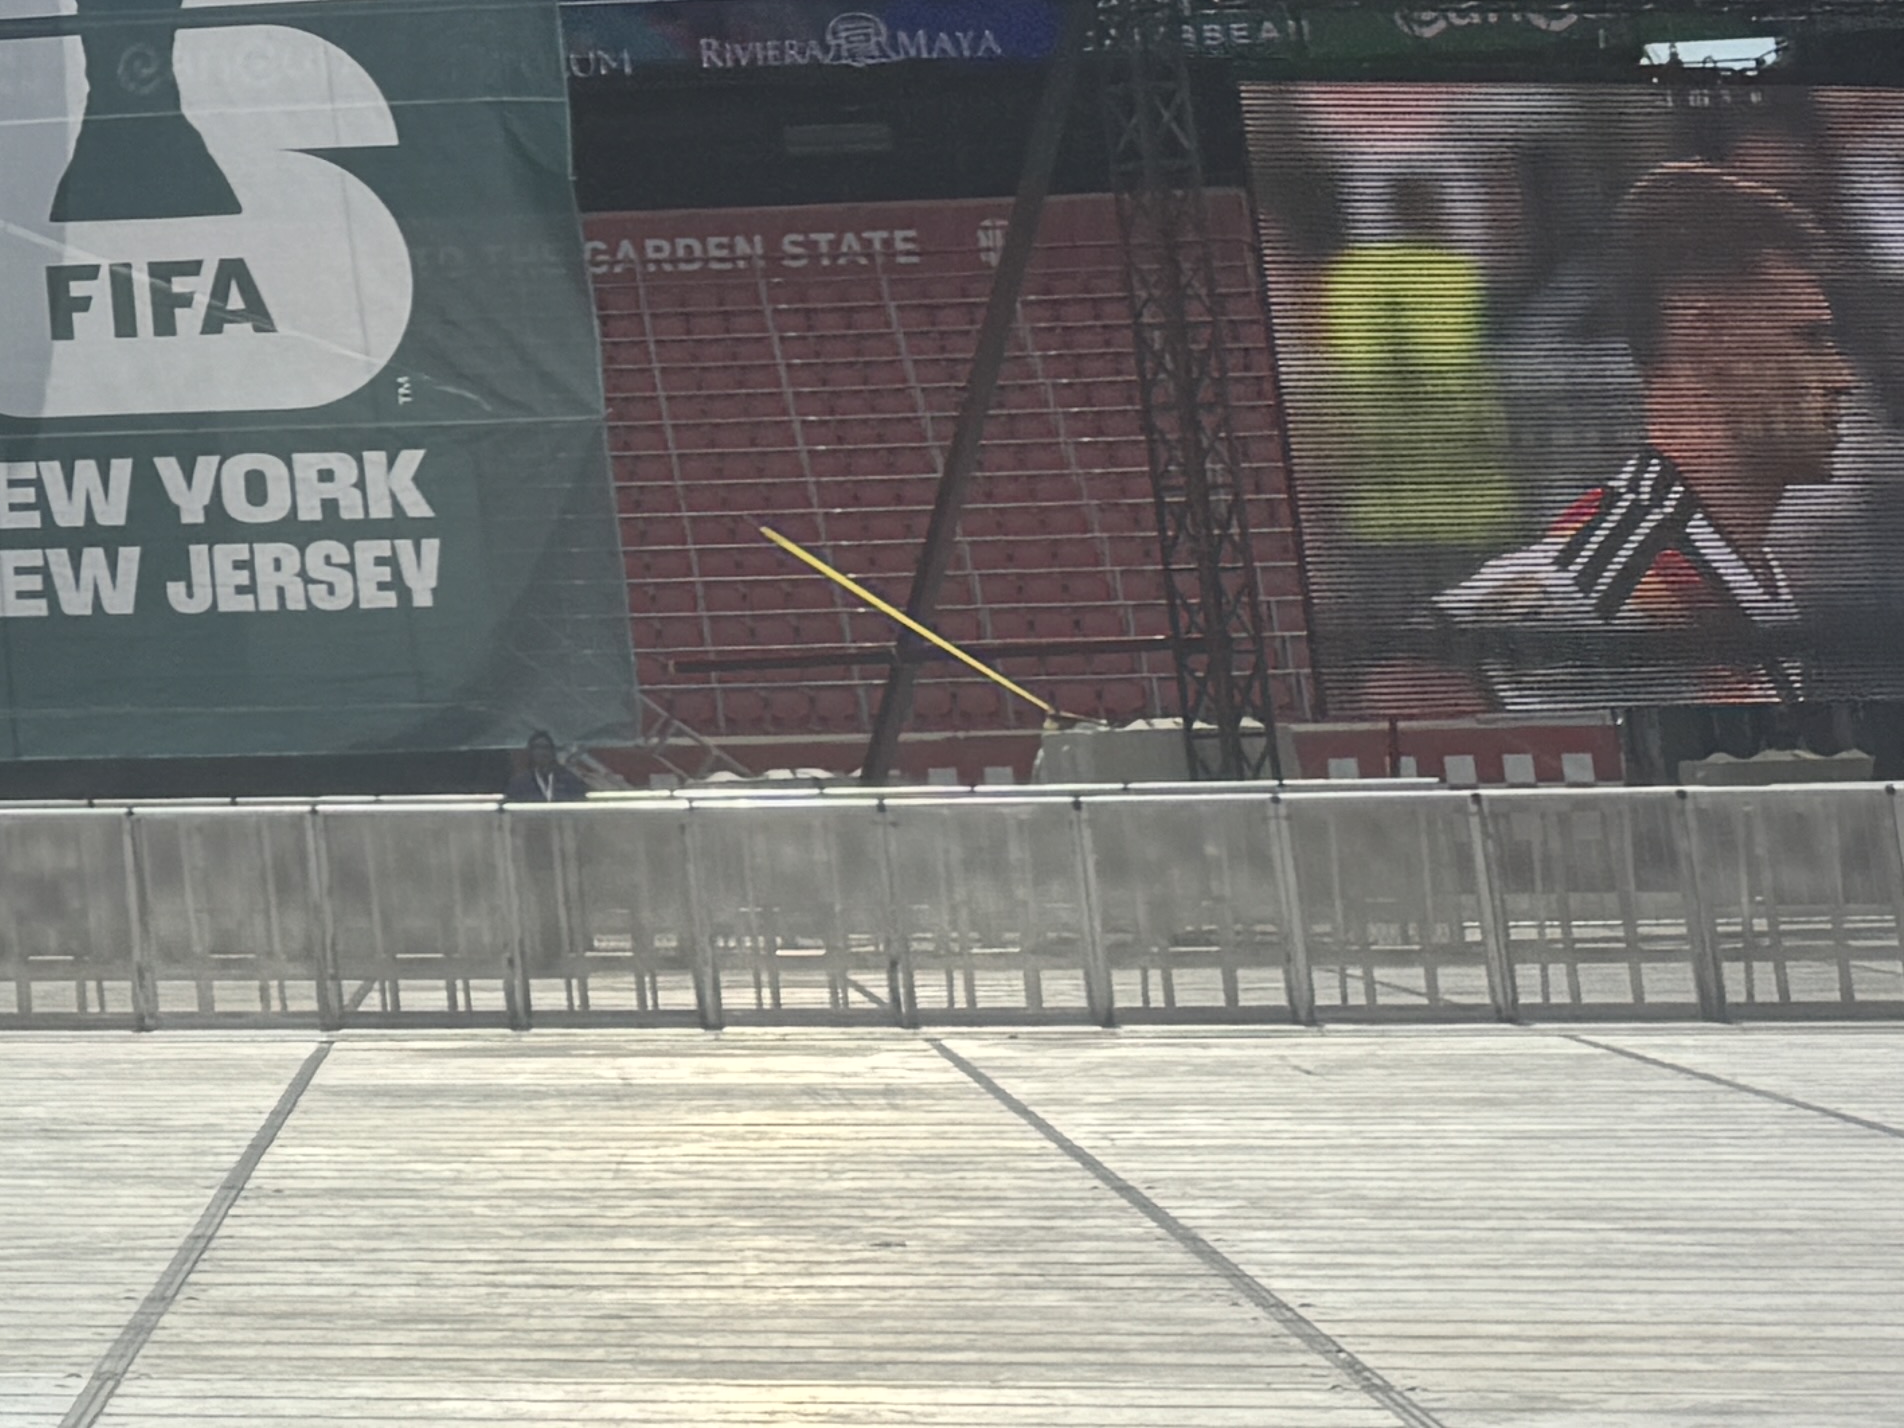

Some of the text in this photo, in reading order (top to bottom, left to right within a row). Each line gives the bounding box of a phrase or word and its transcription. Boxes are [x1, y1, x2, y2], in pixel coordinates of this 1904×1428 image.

[698, 28, 1003, 68] RIVIERA MAYA
[584, 234, 764, 275] GARDEN
[781, 228, 920, 268] STATE
[44, 256, 278, 341] FIFA
[153, 448, 435, 526] YORK
[166, 537, 441, 614] JERSEY
